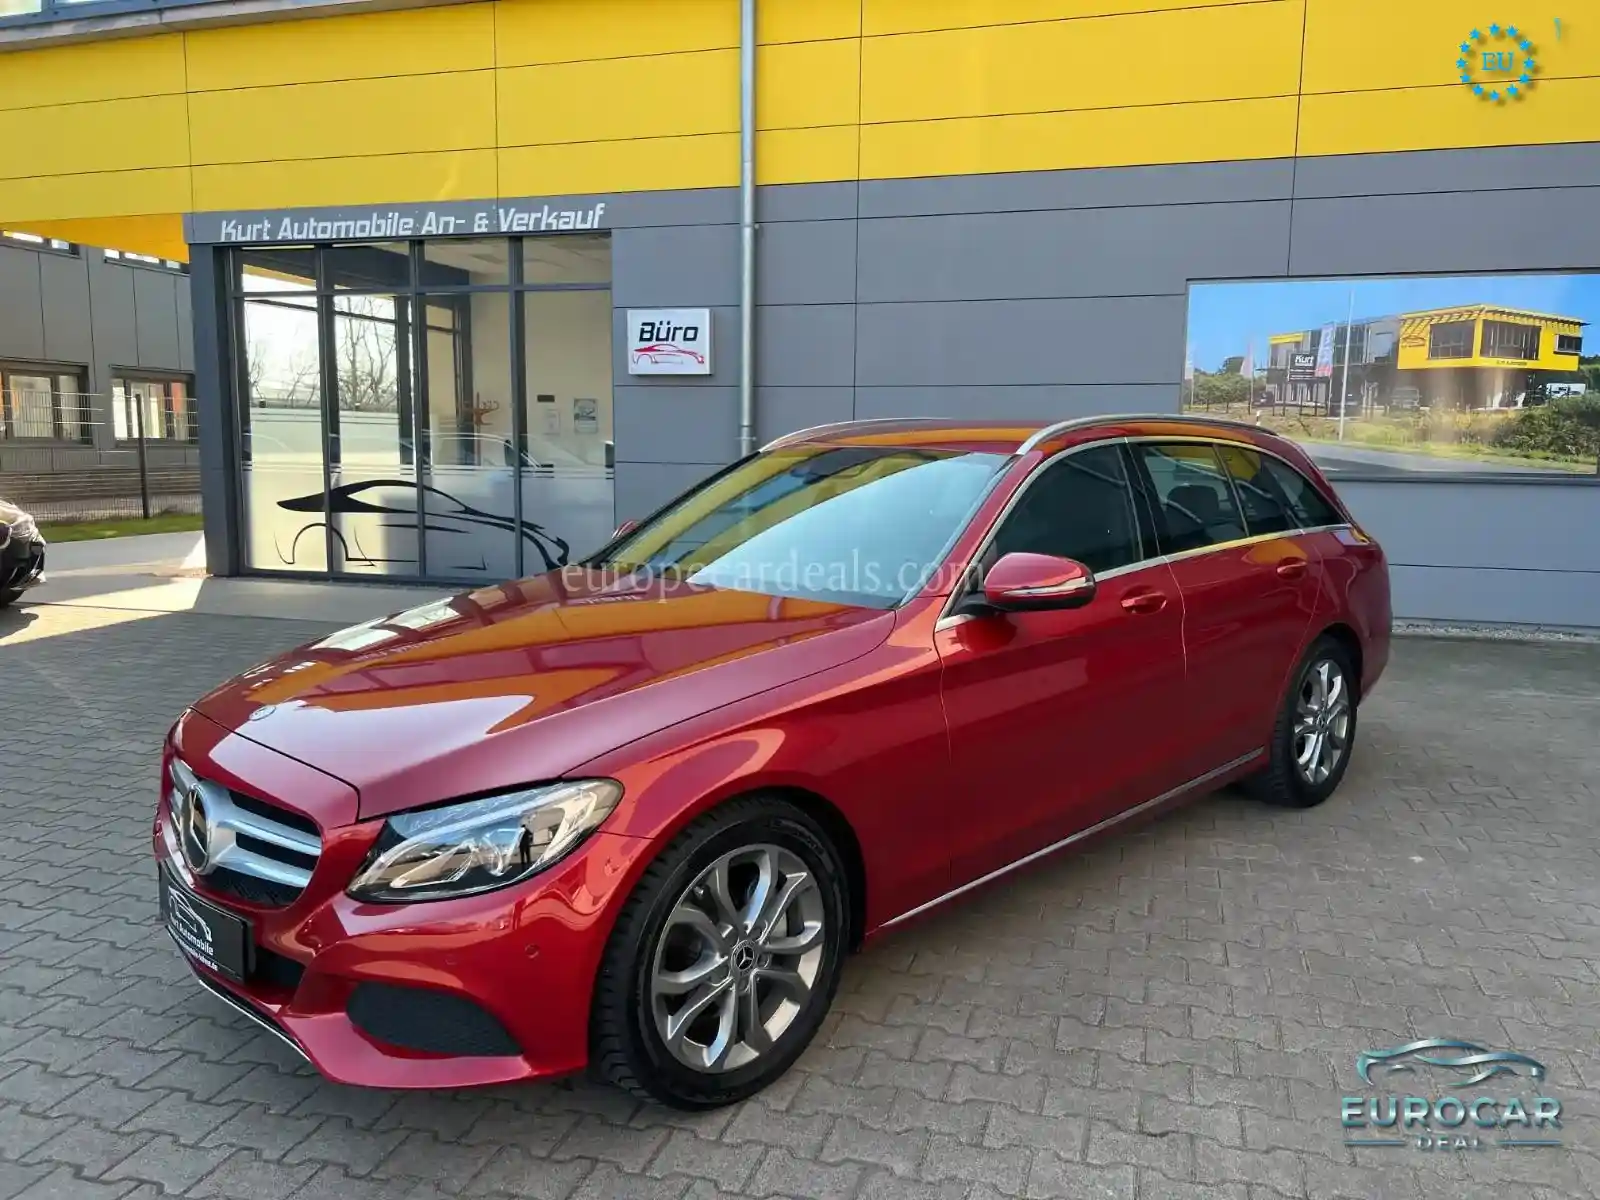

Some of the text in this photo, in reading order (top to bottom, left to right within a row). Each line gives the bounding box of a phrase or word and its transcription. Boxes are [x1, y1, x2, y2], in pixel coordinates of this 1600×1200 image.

[220, 203, 606, 242] Kurt Automobile An- & Verkauf
[638, 320, 699, 342] Büro
